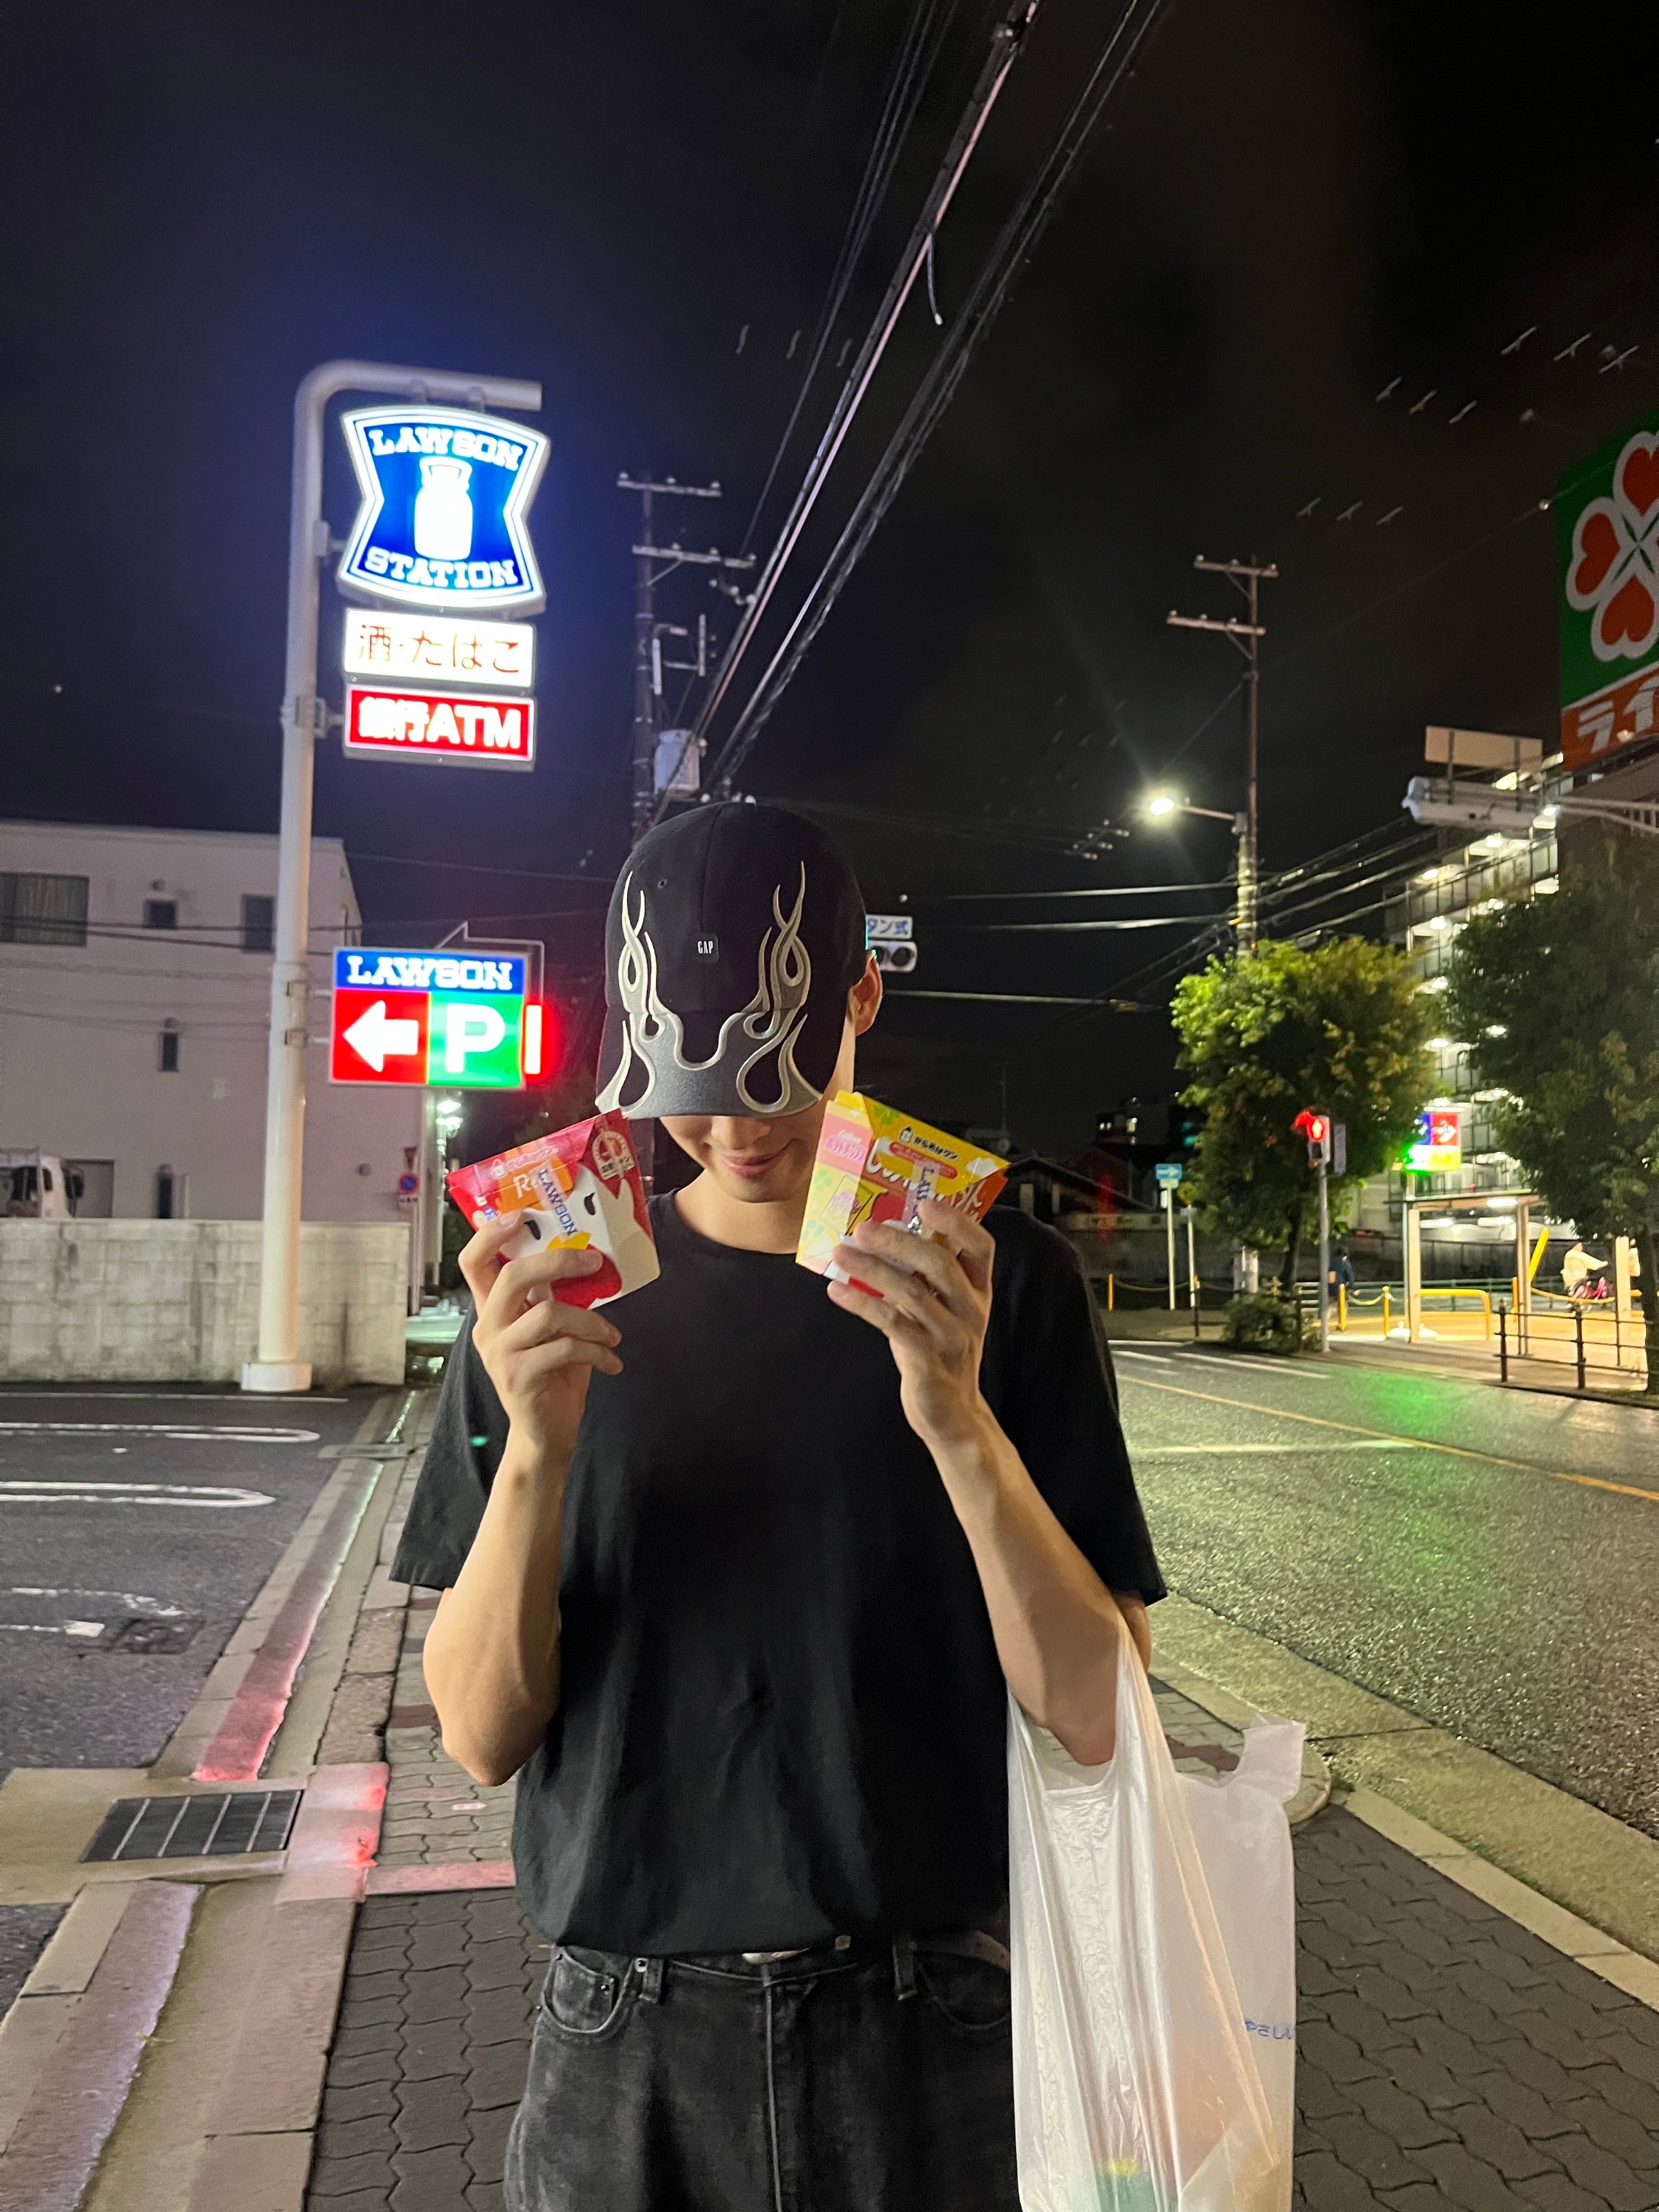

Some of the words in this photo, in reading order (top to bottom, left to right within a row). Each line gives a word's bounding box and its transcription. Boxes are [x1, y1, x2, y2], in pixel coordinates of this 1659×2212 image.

[368, 427, 524, 472] LAWSON
[364, 547, 519, 589] STATION
[697, 940, 714, 954] GAP
[347, 956, 513, 990] LAWSON
[445, 1004, 505, 1073] P
[538, 1168, 578, 1237] LAWSON
